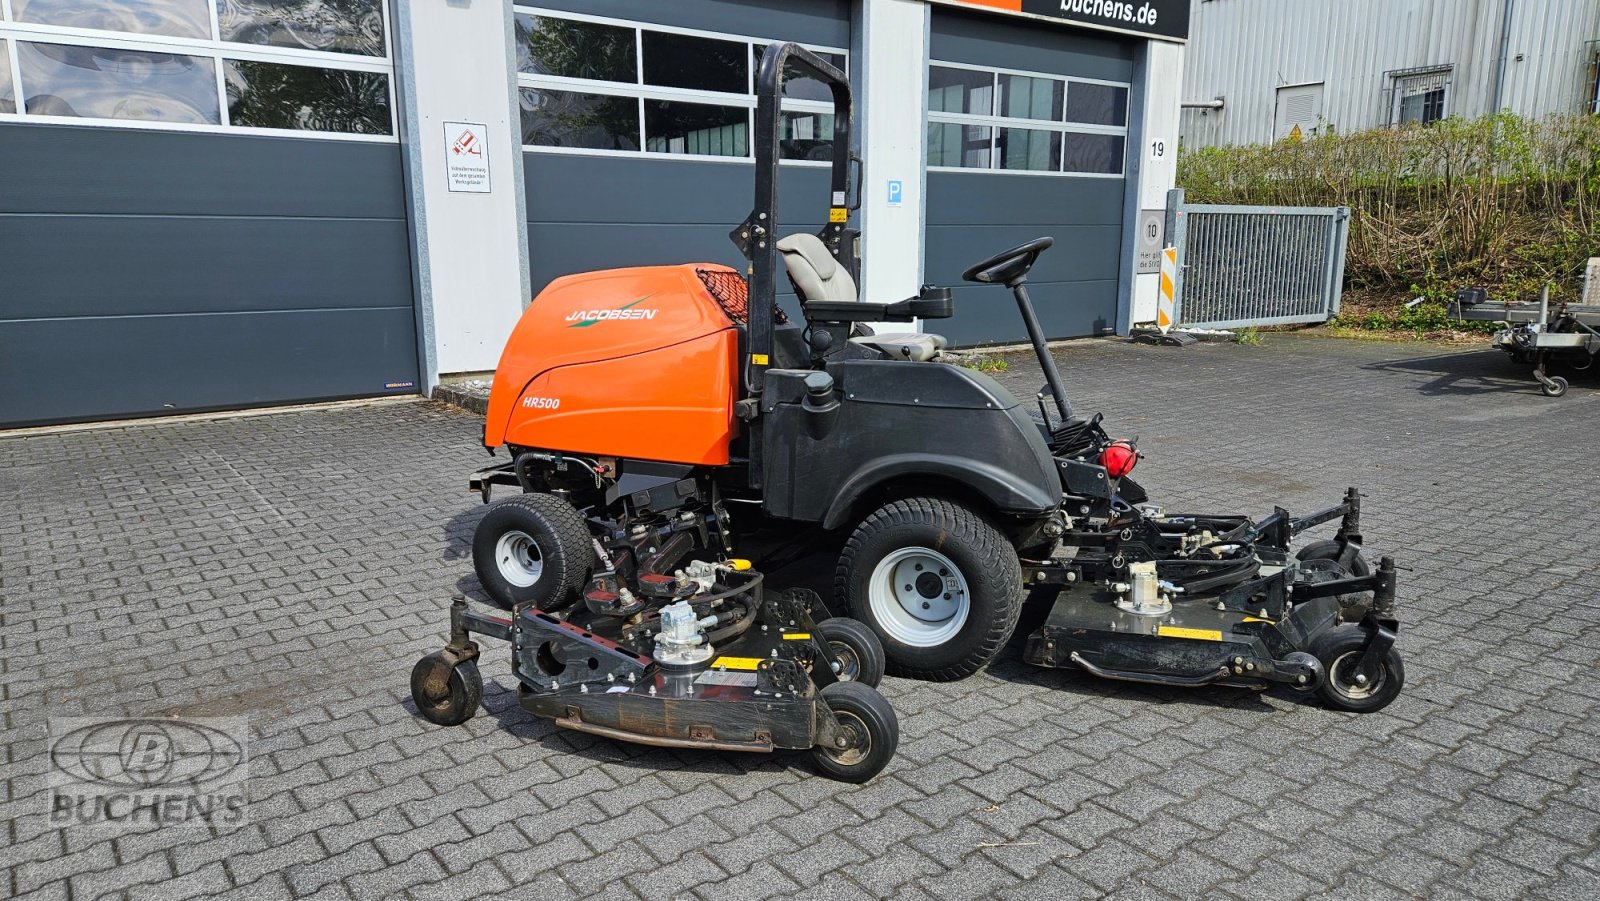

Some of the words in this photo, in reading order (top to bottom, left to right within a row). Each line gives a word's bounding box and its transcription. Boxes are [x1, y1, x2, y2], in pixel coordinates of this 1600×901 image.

[1151, 141, 1164, 156] 19
[890, 183, 900, 200] P
[1148, 224, 1156, 237] 10
[565, 309, 657, 321] JACOBSEN
[522, 396, 560, 409] HR500
